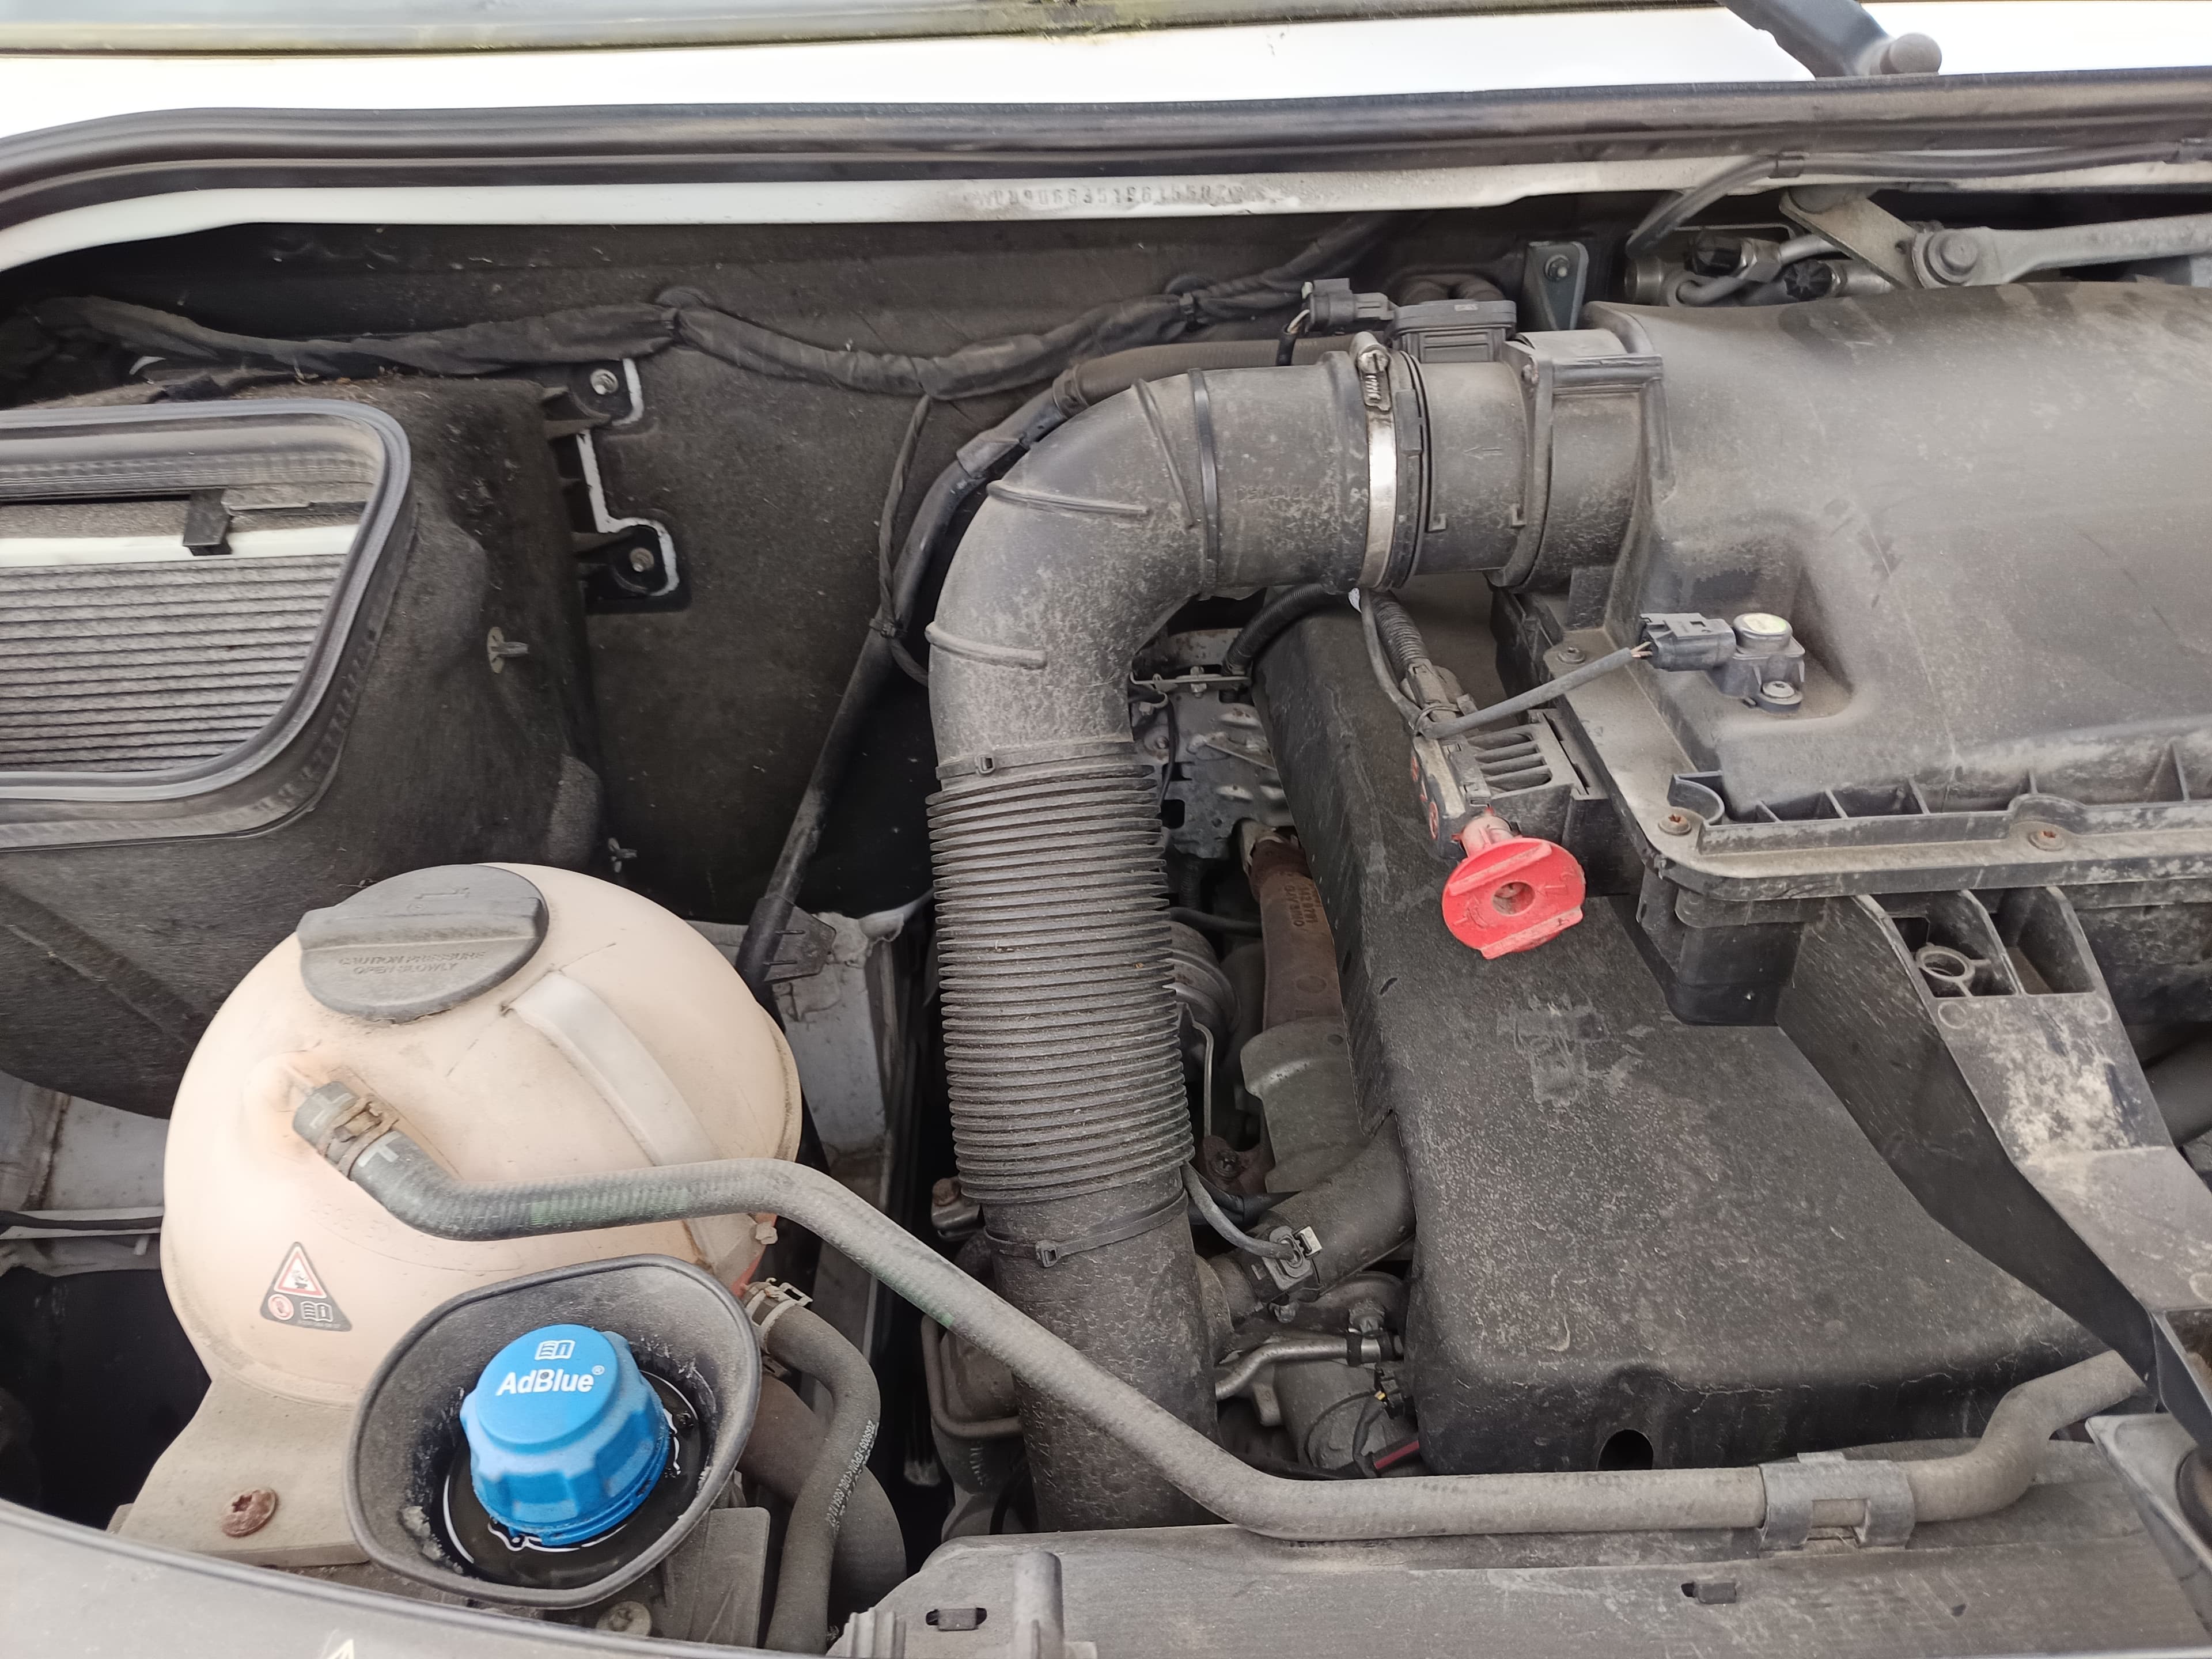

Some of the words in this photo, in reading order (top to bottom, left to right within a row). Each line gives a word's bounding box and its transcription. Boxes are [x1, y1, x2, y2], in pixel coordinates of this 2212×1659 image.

[339, 956, 404, 965] CAUTION
[405, 951, 486, 964] PRESSURE
[354, 965, 392, 974] OPEN
